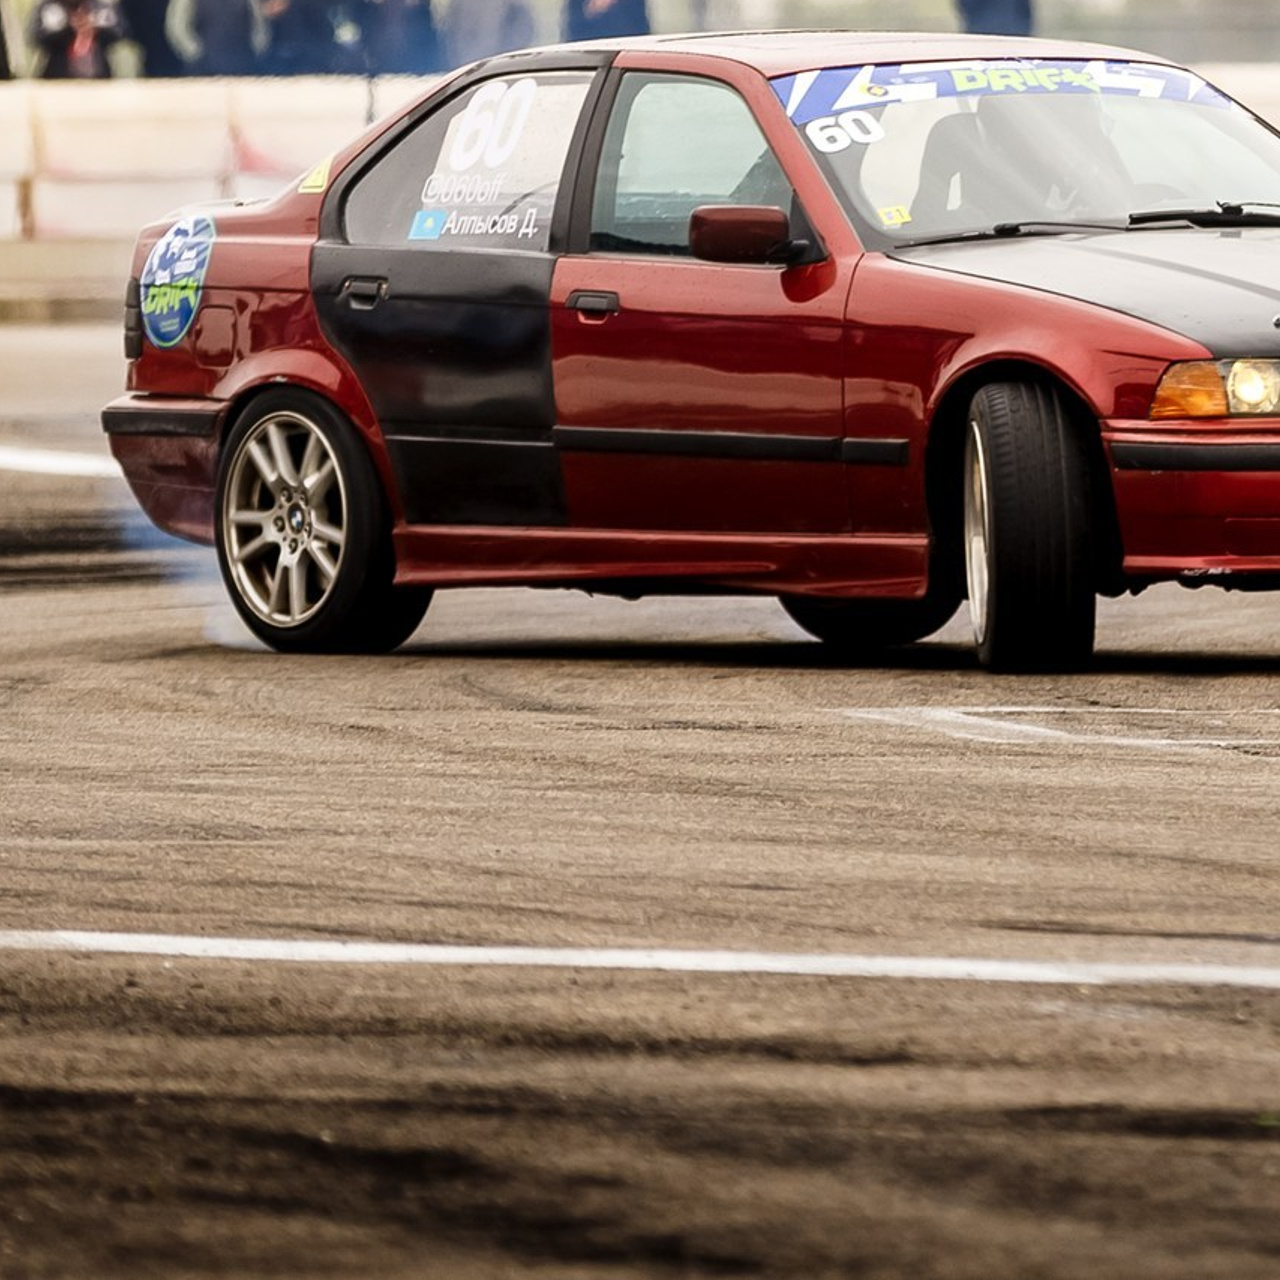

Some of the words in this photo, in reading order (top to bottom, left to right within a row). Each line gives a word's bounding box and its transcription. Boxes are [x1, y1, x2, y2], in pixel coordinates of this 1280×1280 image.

[450, 77, 538, 171] 60
[804, 109, 886, 154] 60
[441, 210, 519, 235] Алпысов
[517, 207, 539, 239] Д.
